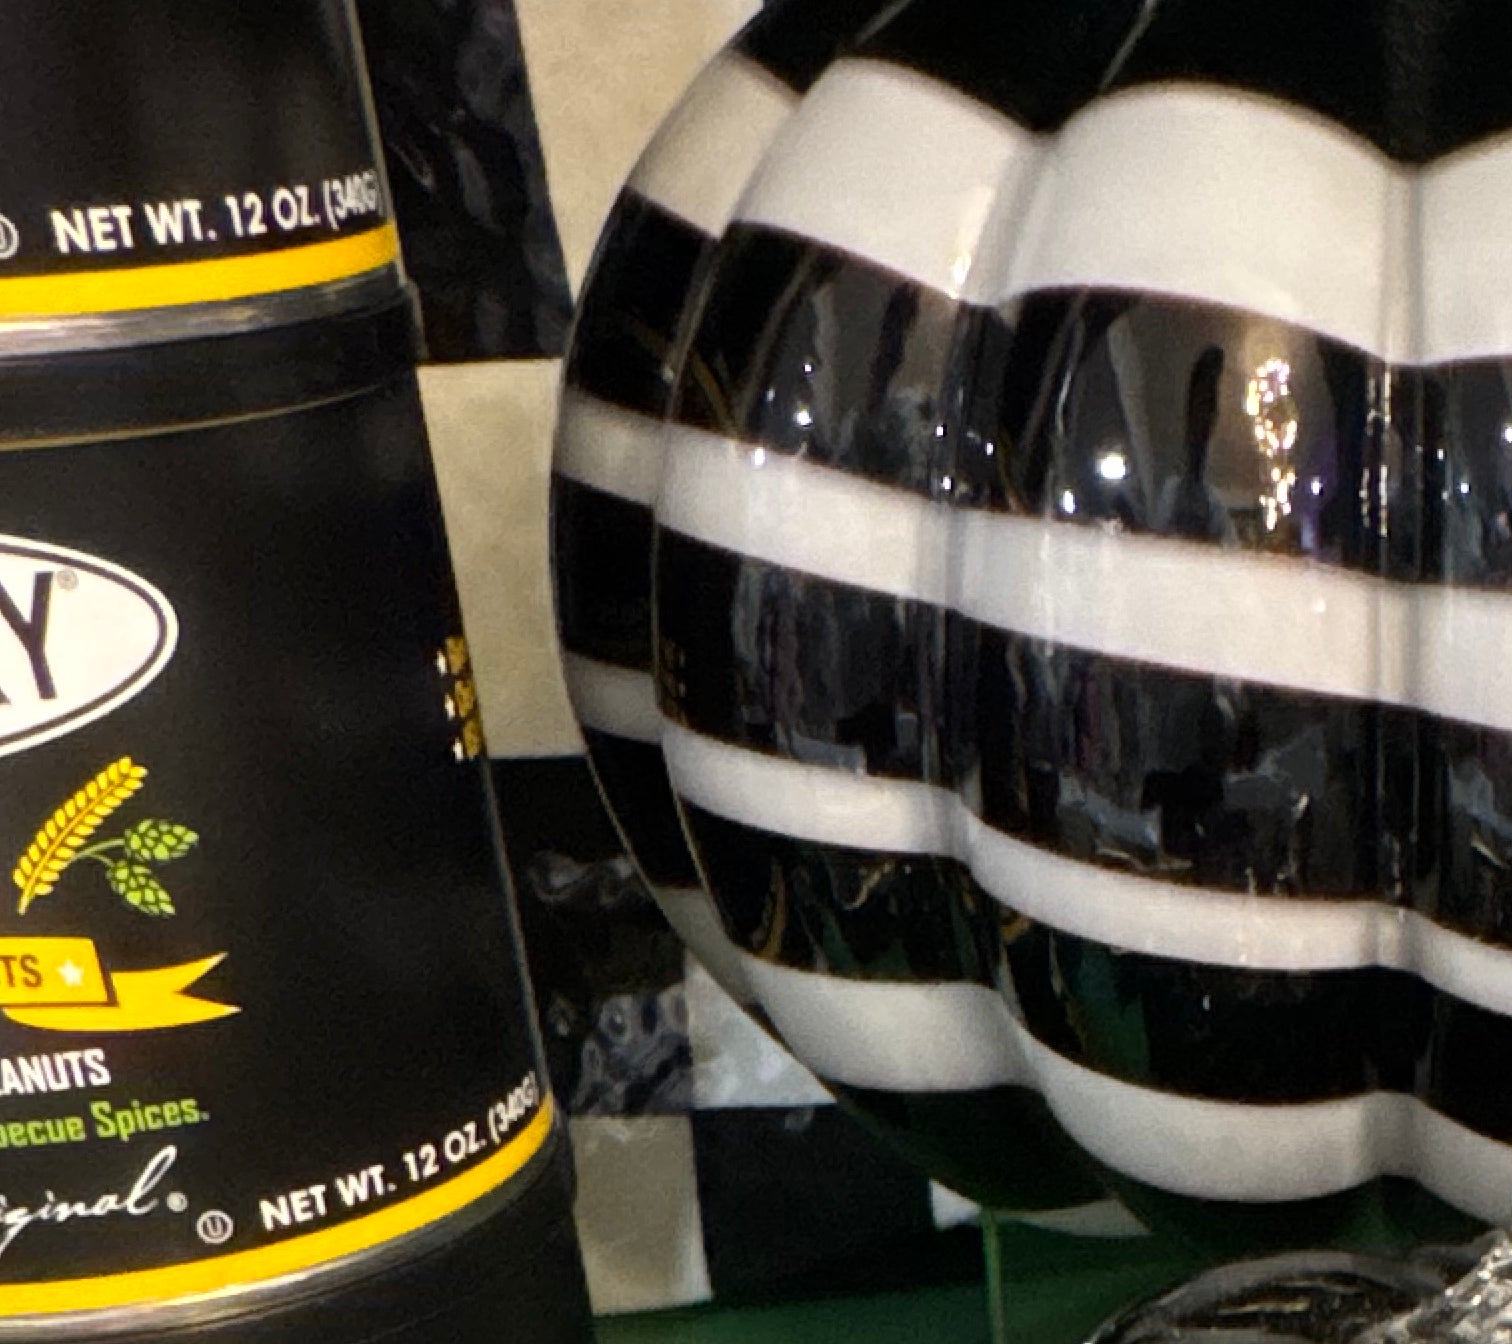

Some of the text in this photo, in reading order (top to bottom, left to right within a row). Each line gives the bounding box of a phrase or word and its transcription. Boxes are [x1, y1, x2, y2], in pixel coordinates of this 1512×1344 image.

[50, 205, 133, 254] NET
[145, 198, 217, 246] WT.
[225, 192, 268, 237] 12
[271, 184, 321, 230] OZ.
[90, 1099, 210, 1142] Spices.
[258, 1184, 327, 1232] NET
[335, 1164, 397, 1206] WT.
[402, 1143, 440, 1182] 12
[443, 1121, 487, 1164] OZ.
